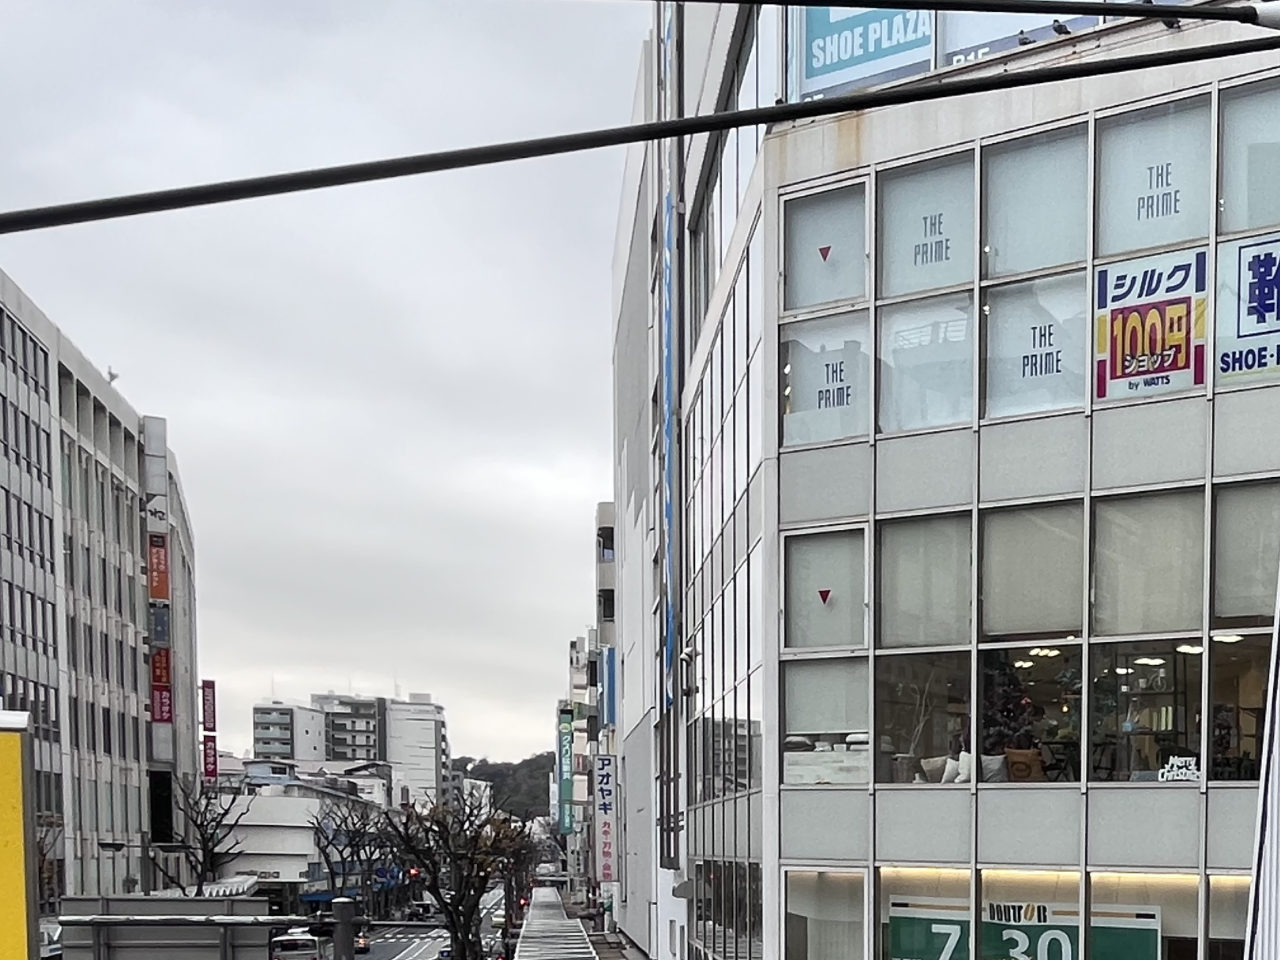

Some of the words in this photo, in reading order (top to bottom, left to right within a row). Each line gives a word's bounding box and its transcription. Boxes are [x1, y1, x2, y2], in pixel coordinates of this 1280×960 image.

[811, 26, 864, 69] SHOE
[868, 10, 931, 52] PLAZA
[1146, 163, 1172, 190] THE
[1137, 190, 1181, 221] PRIME
[922, 213, 944, 238] THE
[914, 238, 951, 267] PRIME
[1111, 262, 1192, 303] シルク
[1030, 324, 1054, 350] THE
[1113, 303, 1188, 376] 100円
[824, 361, 845, 385] THE
[1022, 350, 1062, 378] PRIME
[1124, 347, 1176, 372] ショップ
[1128, 379, 1139, 391] by
[1143, 375, 1171, 387] WATTS
[818, 385, 852, 410] PRIME
[598, 758, 613, 816] アオヤギ
